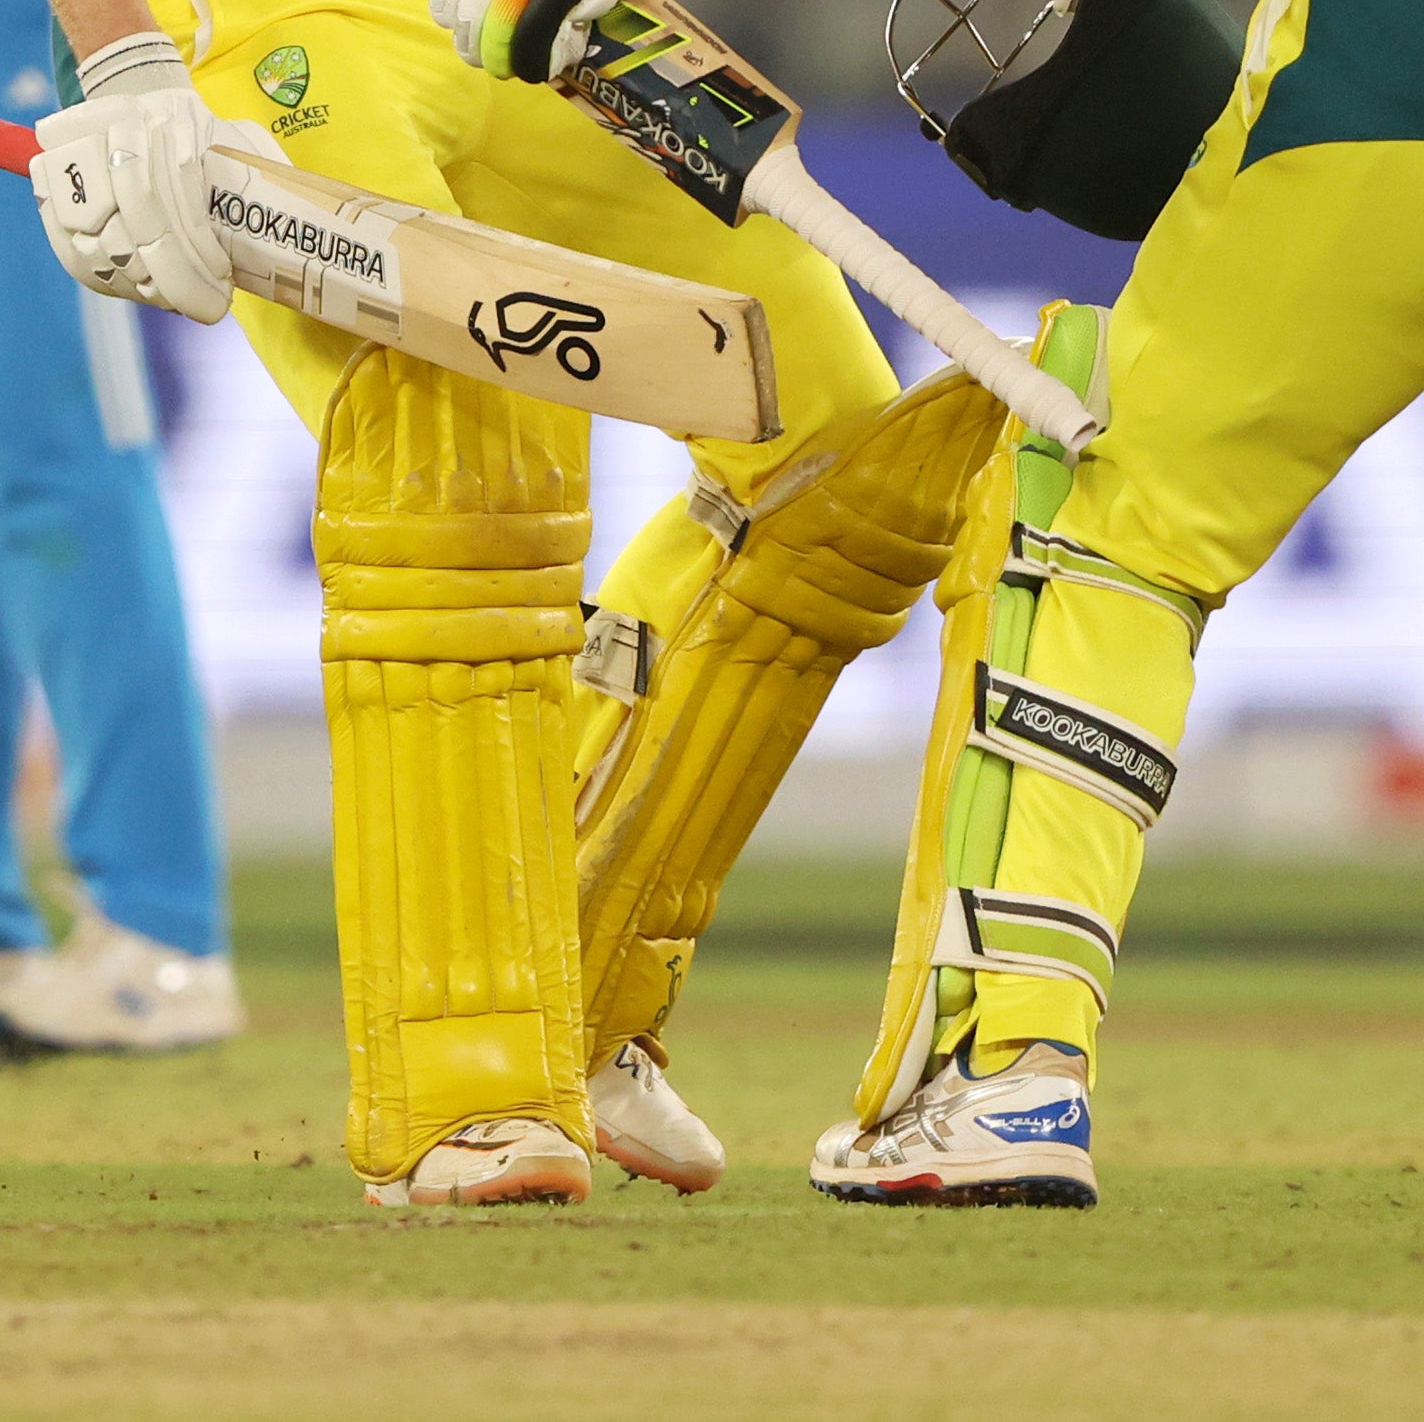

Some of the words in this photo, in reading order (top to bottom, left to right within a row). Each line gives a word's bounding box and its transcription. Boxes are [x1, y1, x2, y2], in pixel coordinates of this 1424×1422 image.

[271, 104, 330, 134] CRICKET
[283, 118, 328, 139] AUSTRALIA
[208, 184, 387, 287] KOOKABURRA
[1012, 697, 1171, 798] KOOKABURRA
